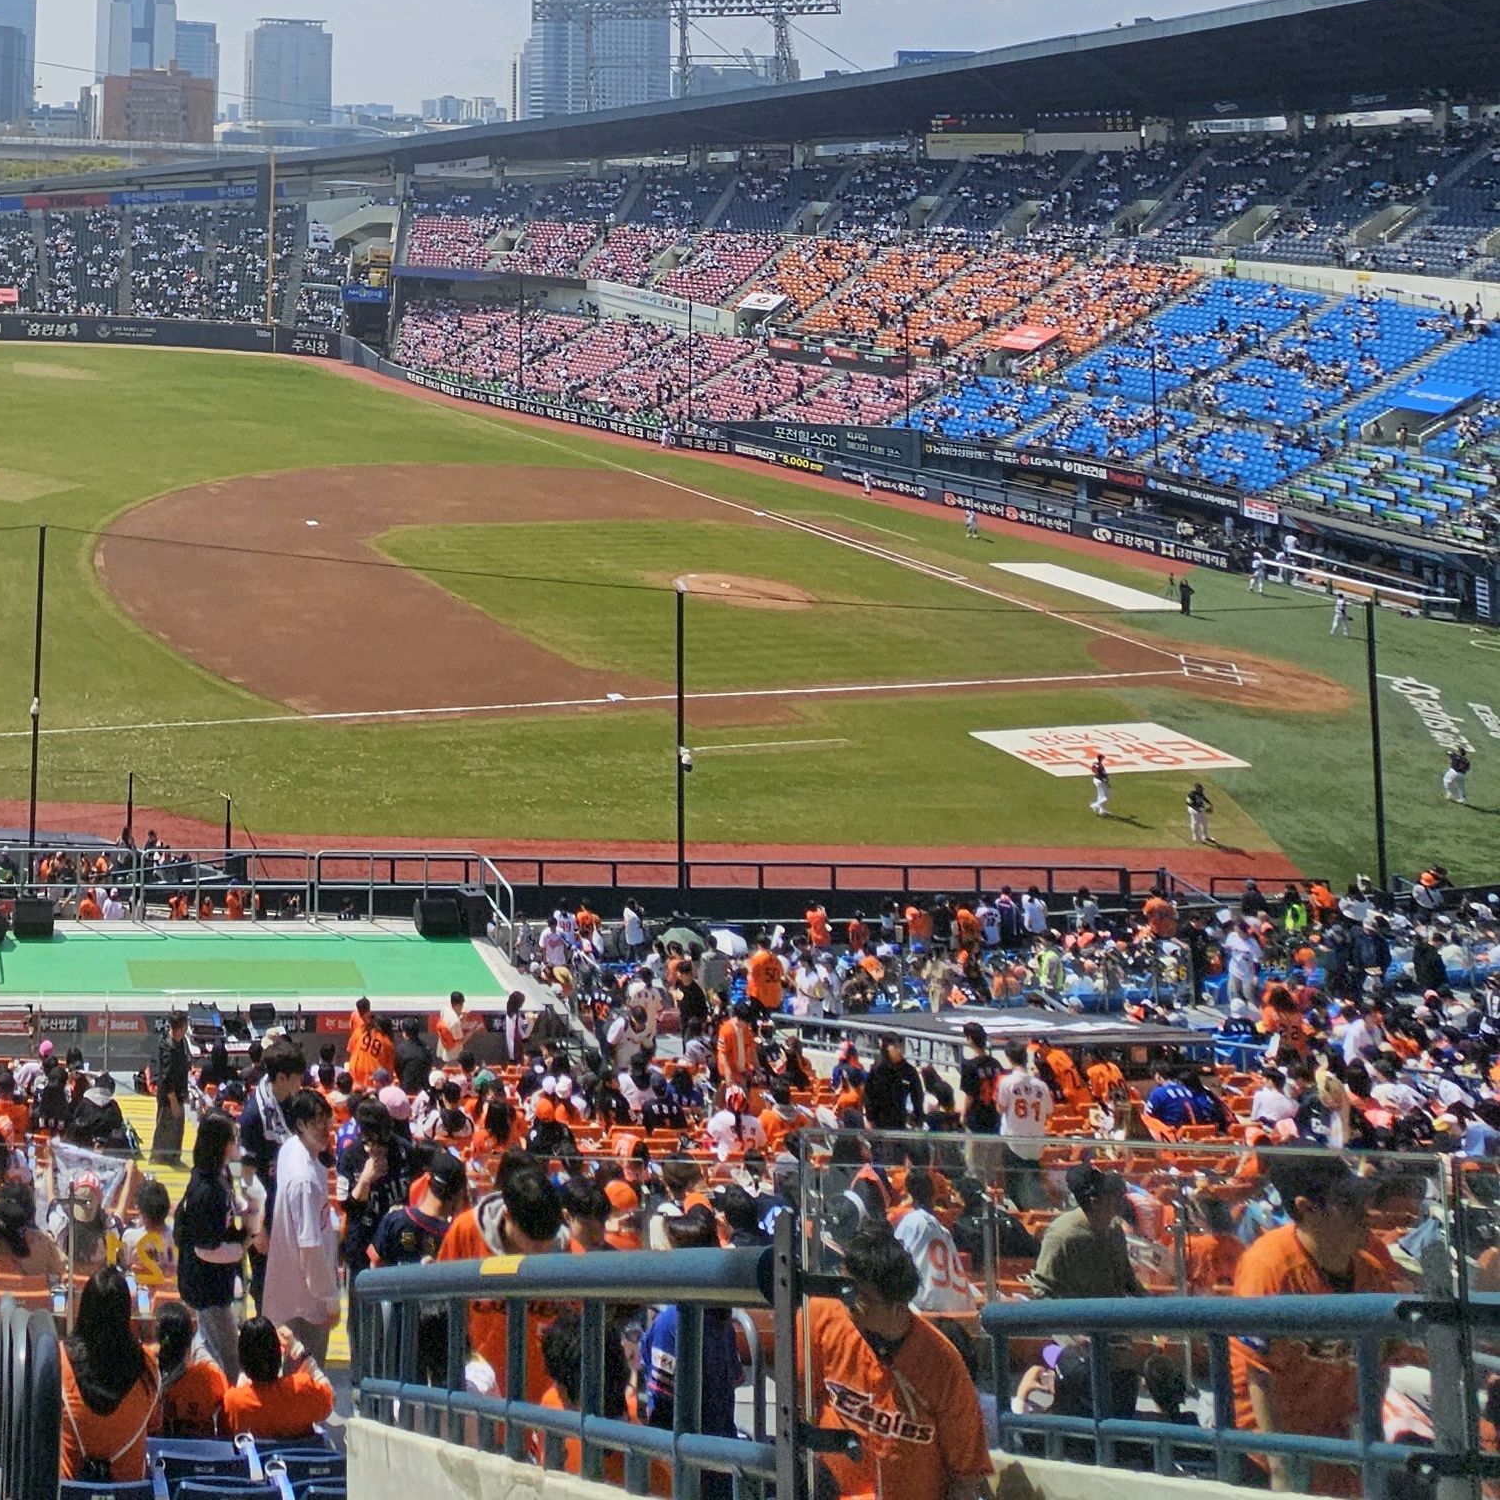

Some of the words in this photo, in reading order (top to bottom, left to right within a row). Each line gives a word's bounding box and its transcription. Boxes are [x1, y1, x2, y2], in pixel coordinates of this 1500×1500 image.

[255, 329, 272, 338] 100m
[291, 338, 330, 356] 주식창
[546, 407, 578, 423] 백조씽크
[610, 421, 644, 439] 백조씽크
[681, 436, 729, 452] 백조씽크
[774, 426, 837, 448] 포천힐스CC
[1114, 531, 1155, 553] 금강주택
[1015, 739, 1232, 770] 백조씽크
[41, 1017, 78, 1031] 두산밥캣
[110, 1019, 139, 1031] Bobcat
[361, 1034, 383, 1058] 99
[824, 1379, 935, 1444] Eagles
